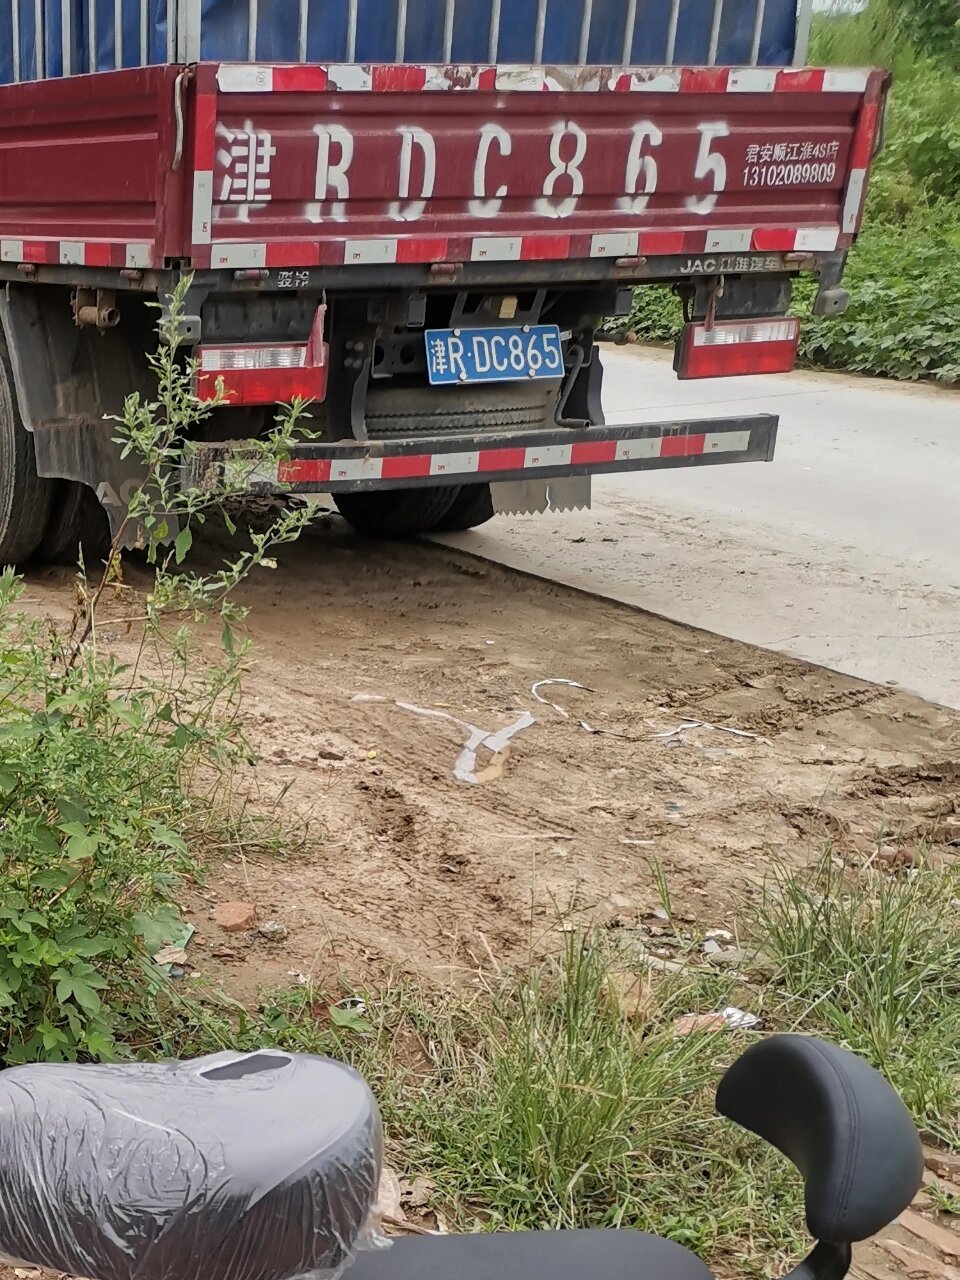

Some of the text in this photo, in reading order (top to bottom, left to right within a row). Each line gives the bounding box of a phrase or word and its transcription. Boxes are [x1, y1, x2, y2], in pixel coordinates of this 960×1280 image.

[745, 140, 839, 164] 君安顺江淮4S店
[743, 162, 836, 187] 13102089809
[680, 256, 779, 274] JAC 江淮汽车
